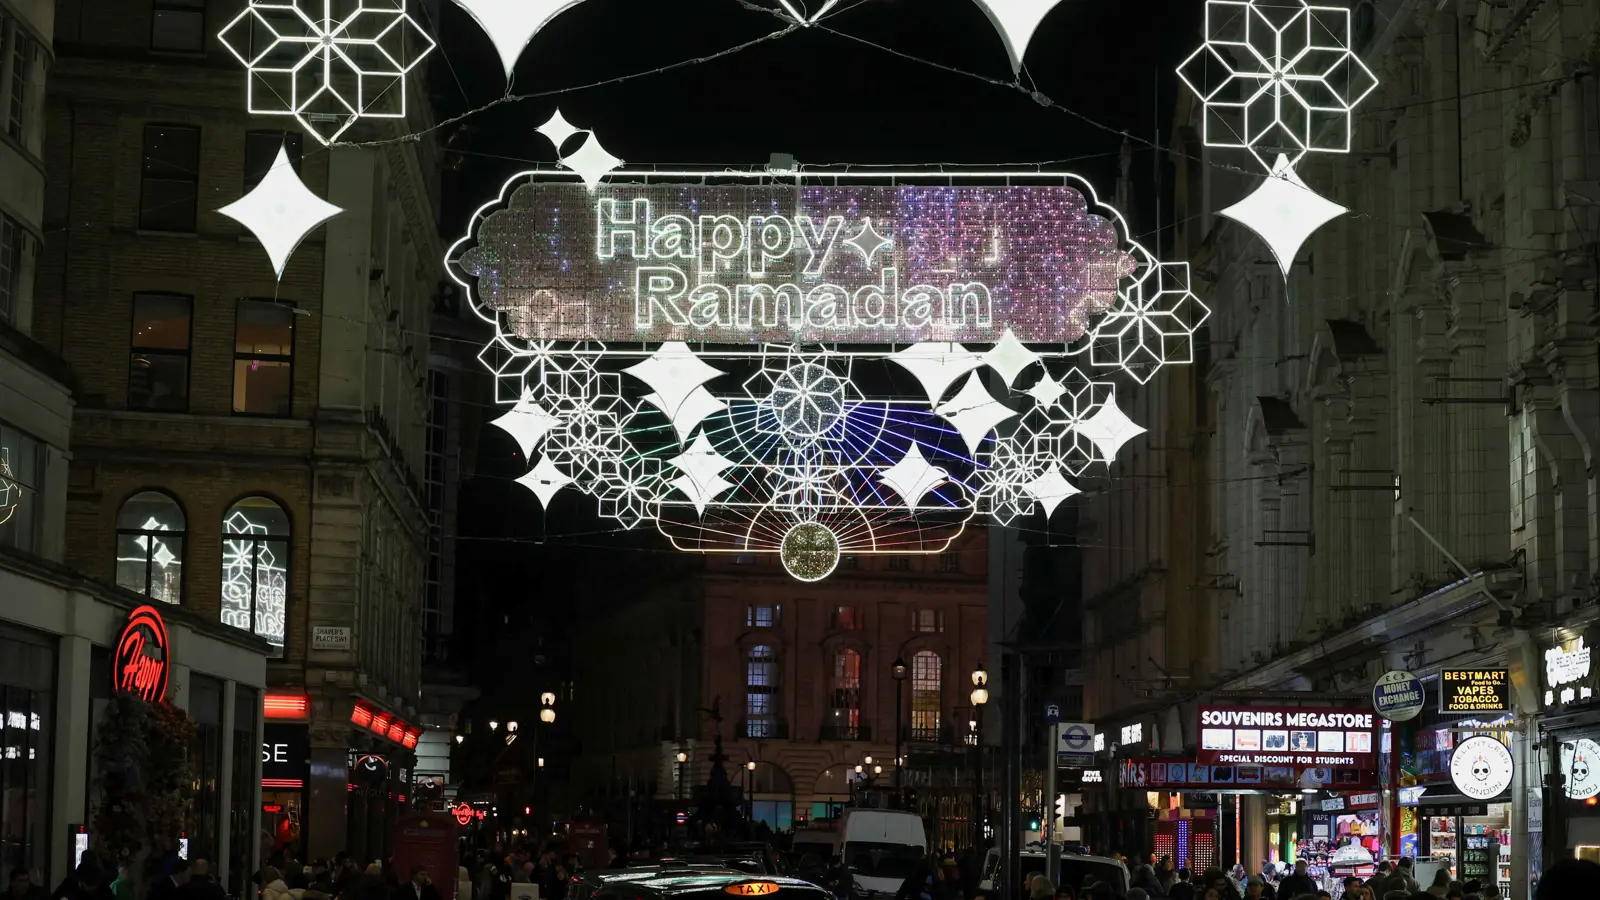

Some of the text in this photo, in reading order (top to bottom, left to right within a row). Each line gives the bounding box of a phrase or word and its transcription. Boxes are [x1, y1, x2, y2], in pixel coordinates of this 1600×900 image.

[598, 198, 845, 275] Happy
[636, 267, 993, 328] Ramadan
[316, 628, 344, 636] SHAVER'S
[315, 635, 334, 643] PLACE
[122, 631, 165, 702] Happy
[1444, 671, 1506, 680] BESTMART
[1383, 681, 1411, 694] MONEY
[1457, 686, 1495, 695] VAPES
[1378, 690, 1420, 706] EXCHANGE
[1453, 695, 1500, 703] TOBACCO
[1202, 710, 1284, 727] SOUVENIRS
[1286, 712, 1373, 729] MEGASTORE
[1219, 755, 1355, 765] SPECIAL DISCOUNT FOR STUDENTS
[1453, 741, 1510, 767] RELENTLESS
[1463, 781, 1503, 795] LONDON
[738, 884, 771, 894] TAXI
